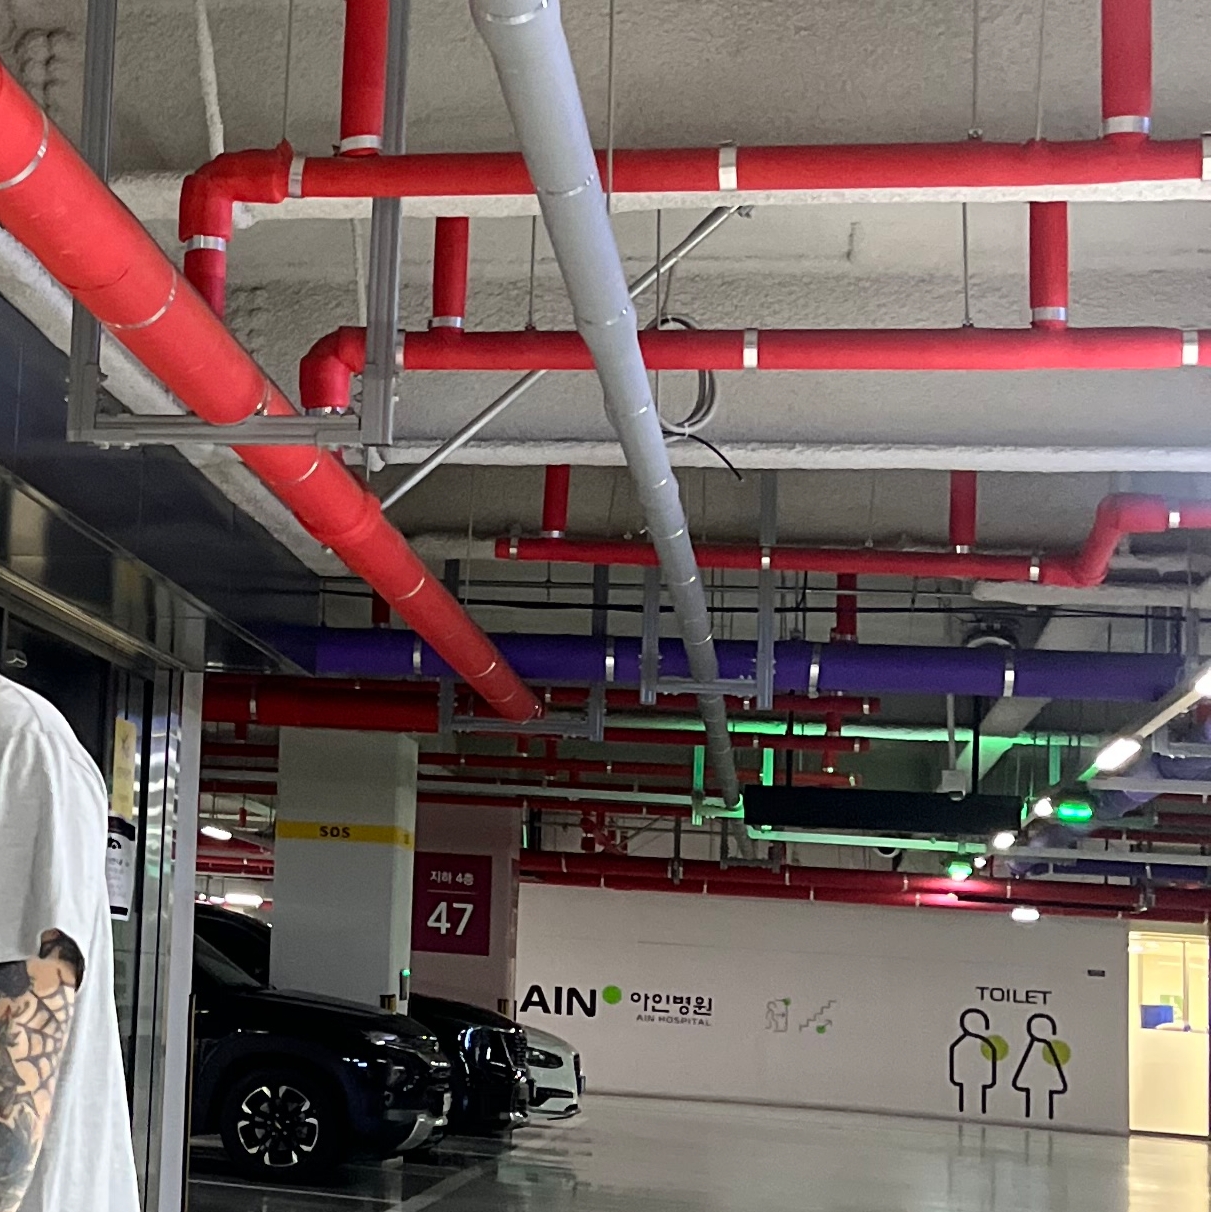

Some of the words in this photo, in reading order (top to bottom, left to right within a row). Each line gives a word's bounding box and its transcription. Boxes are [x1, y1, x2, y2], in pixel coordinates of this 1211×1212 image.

[319, 825, 351, 839] SOS
[429, 870, 453, 885] 지하
[426, 901, 474, 936] 47
[519, 984, 597, 1018] AIN
[630, 992, 713, 1016] 아인병원
[975, 986, 1053, 1005] TOILET
[636, 1013, 655, 1023] AIN
[658, 1015, 712, 1027] HOSPITAL
